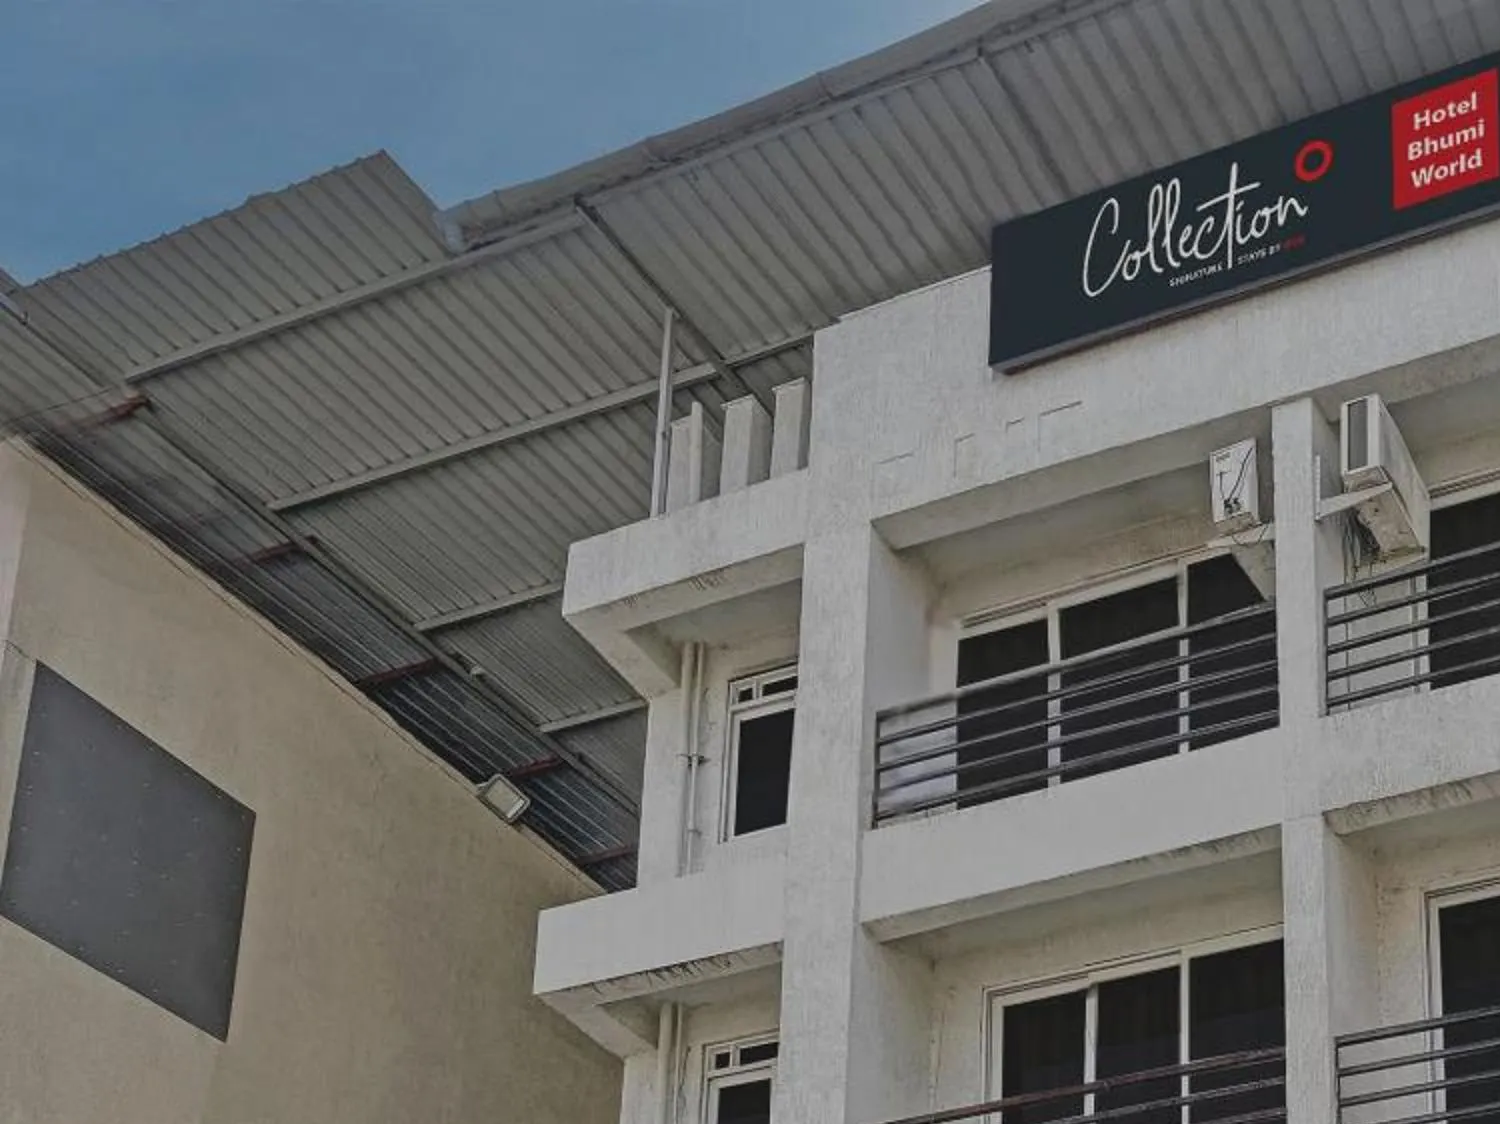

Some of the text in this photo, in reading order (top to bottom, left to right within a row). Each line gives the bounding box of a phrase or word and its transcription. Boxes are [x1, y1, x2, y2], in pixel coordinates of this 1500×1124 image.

[1413, 91, 1477, 130] Hotel
[1407, 118, 1485, 161] Bhumi
[1411, 148, 1483, 188] World
[1083, 162, 1308, 297] Collection
